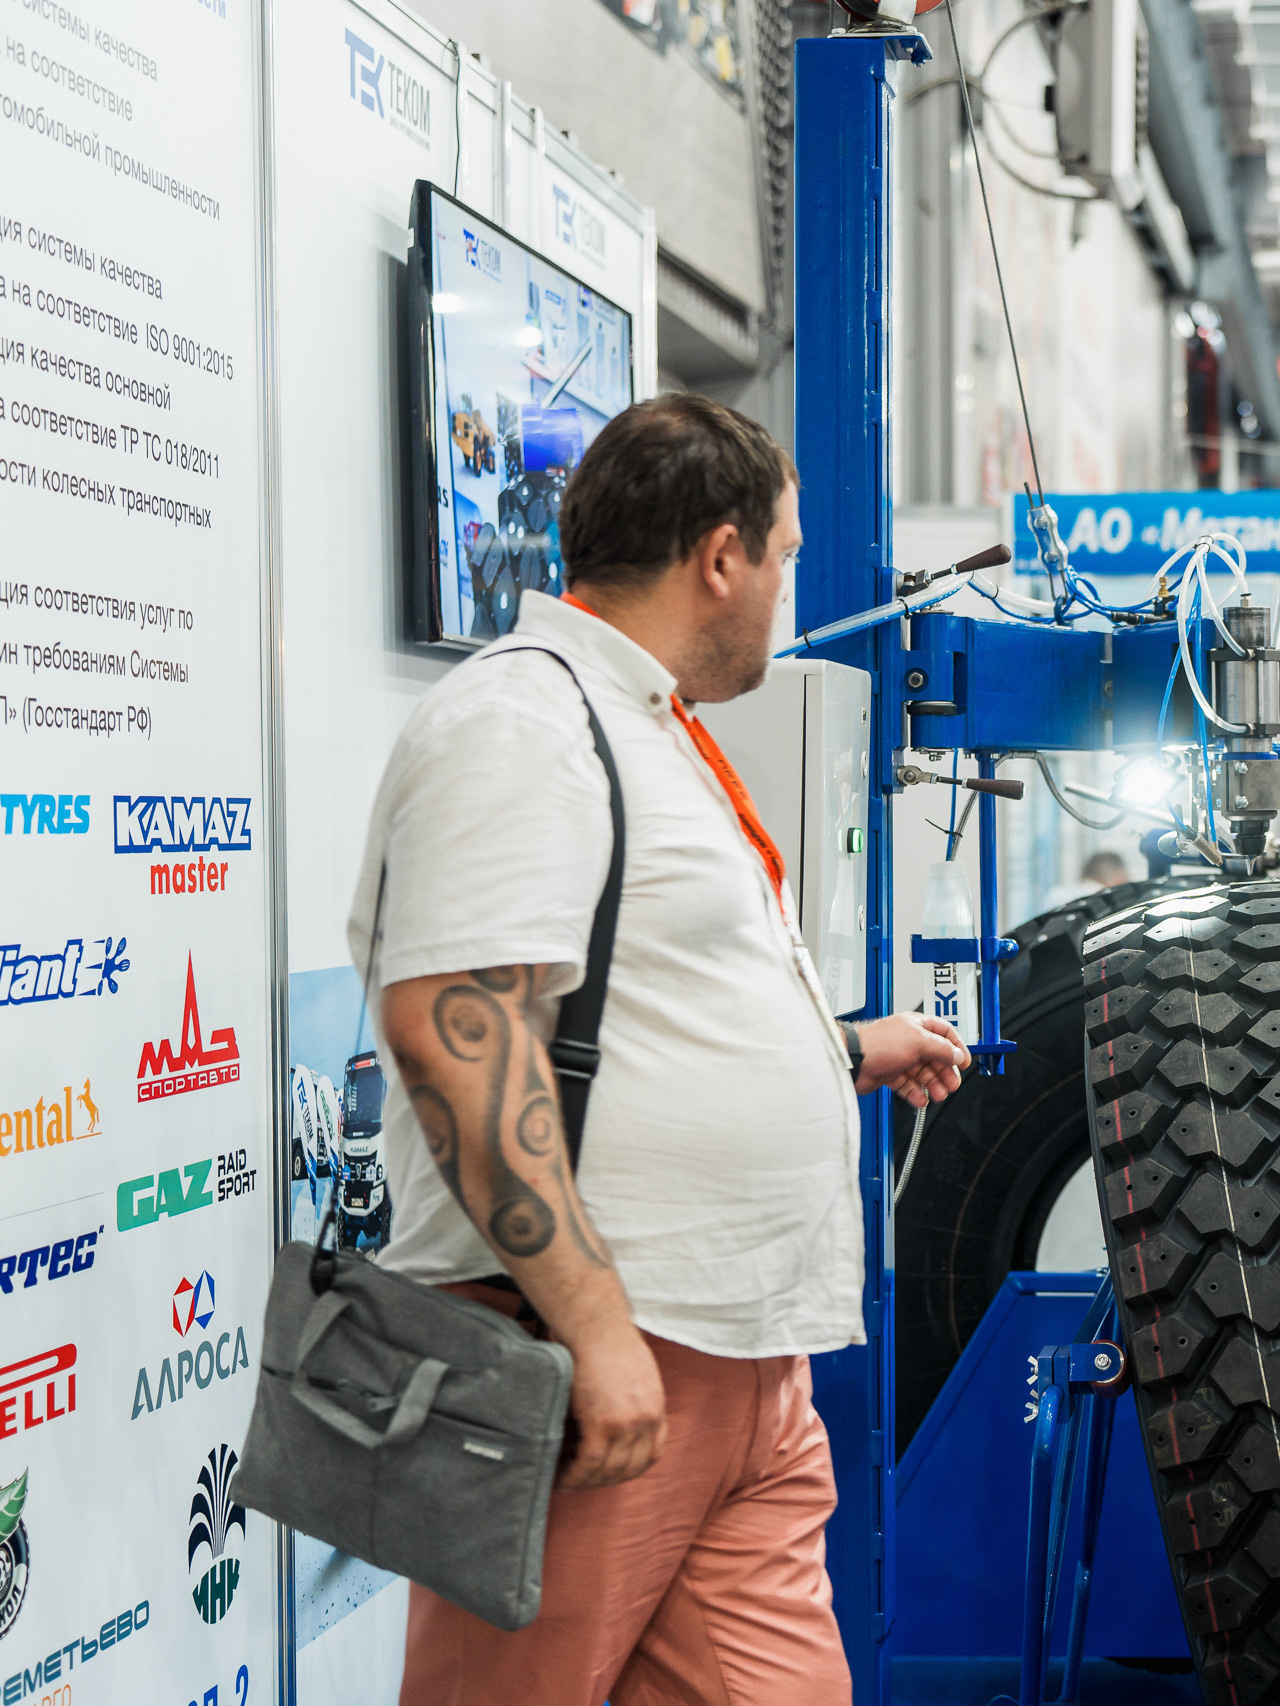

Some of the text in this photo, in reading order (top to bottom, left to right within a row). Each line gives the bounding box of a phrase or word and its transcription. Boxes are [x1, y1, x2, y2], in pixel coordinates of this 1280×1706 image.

[6, 36, 133, 122] на соответствие
[94, 27, 158, 82] качества
[0, 92, 220, 221] омобильной промышленности
[0, 216, 163, 300] ия системы качества
[12, 280, 31, 308] на
[37, 289, 138, 344] соответствие
[146, 322, 170, 356] ISO
[173, 334, 234, 380] 9001:2015
[30, 345, 101, 389] качества
[105, 371, 171, 411] основной
[11, 401, 117, 450] соответствие
[165, 438, 219, 479] 018/2011
[42, 468, 116, 506] колесных
[119, 487, 212, 529] транспортных
[34, 586, 136, 622] соответствия
[139, 603, 175, 633] услуг
[178, 610, 194, 631] по
[23, 641, 126, 677] требованиям
[130, 650, 189, 683] Системы
[22, 697, 123, 738] (Госстандарт
[127, 705, 152, 741] РФ)
[0, 794, 91, 835] TYRES
[113, 795, 252, 854] KAMAZ
[150, 856, 228, 895] master
[138, 1065, 239, 1100] СПОРТАВТО
[116, 1149, 247, 1233] GAZ RAID
[217, 1169, 257, 1202] SPORT
